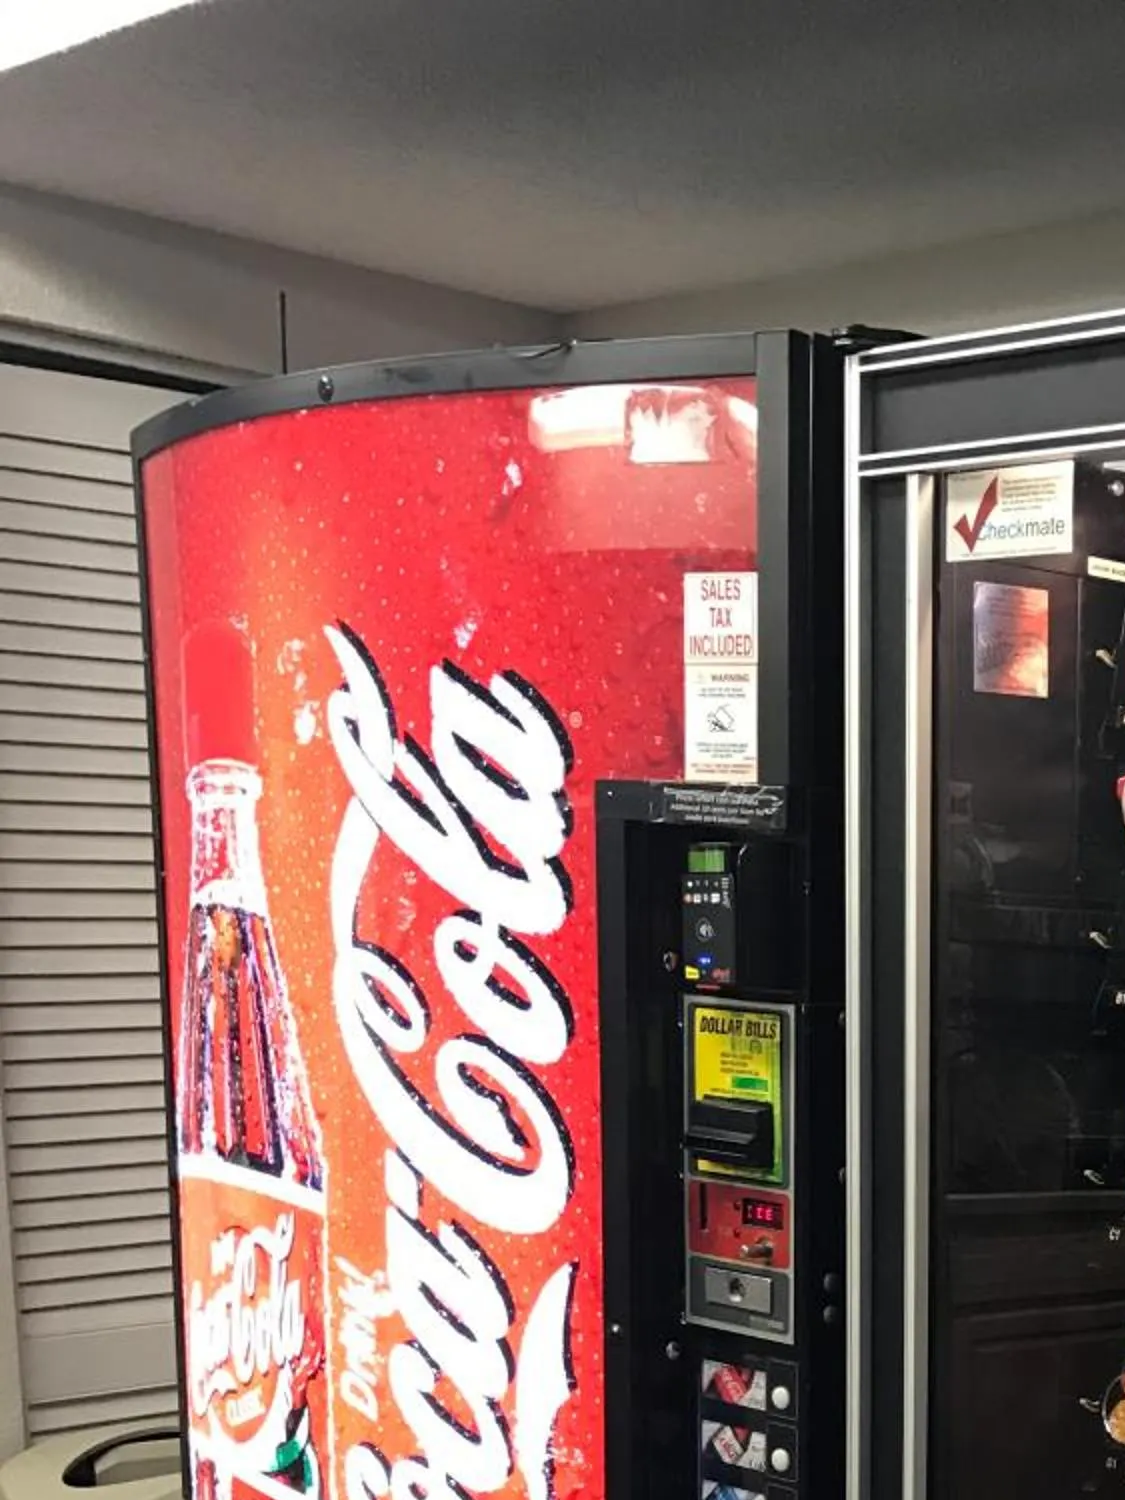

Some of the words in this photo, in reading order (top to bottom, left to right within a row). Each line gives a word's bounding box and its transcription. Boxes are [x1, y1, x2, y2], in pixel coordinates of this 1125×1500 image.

[701, 579, 741, 601] SALES
[709, 607, 733, 627] TAX
[689, 635, 753, 657] INCLUDED
[700, 1016, 742, 1036] DOLLAR
[746, 1020, 777, 1039] BILLS
